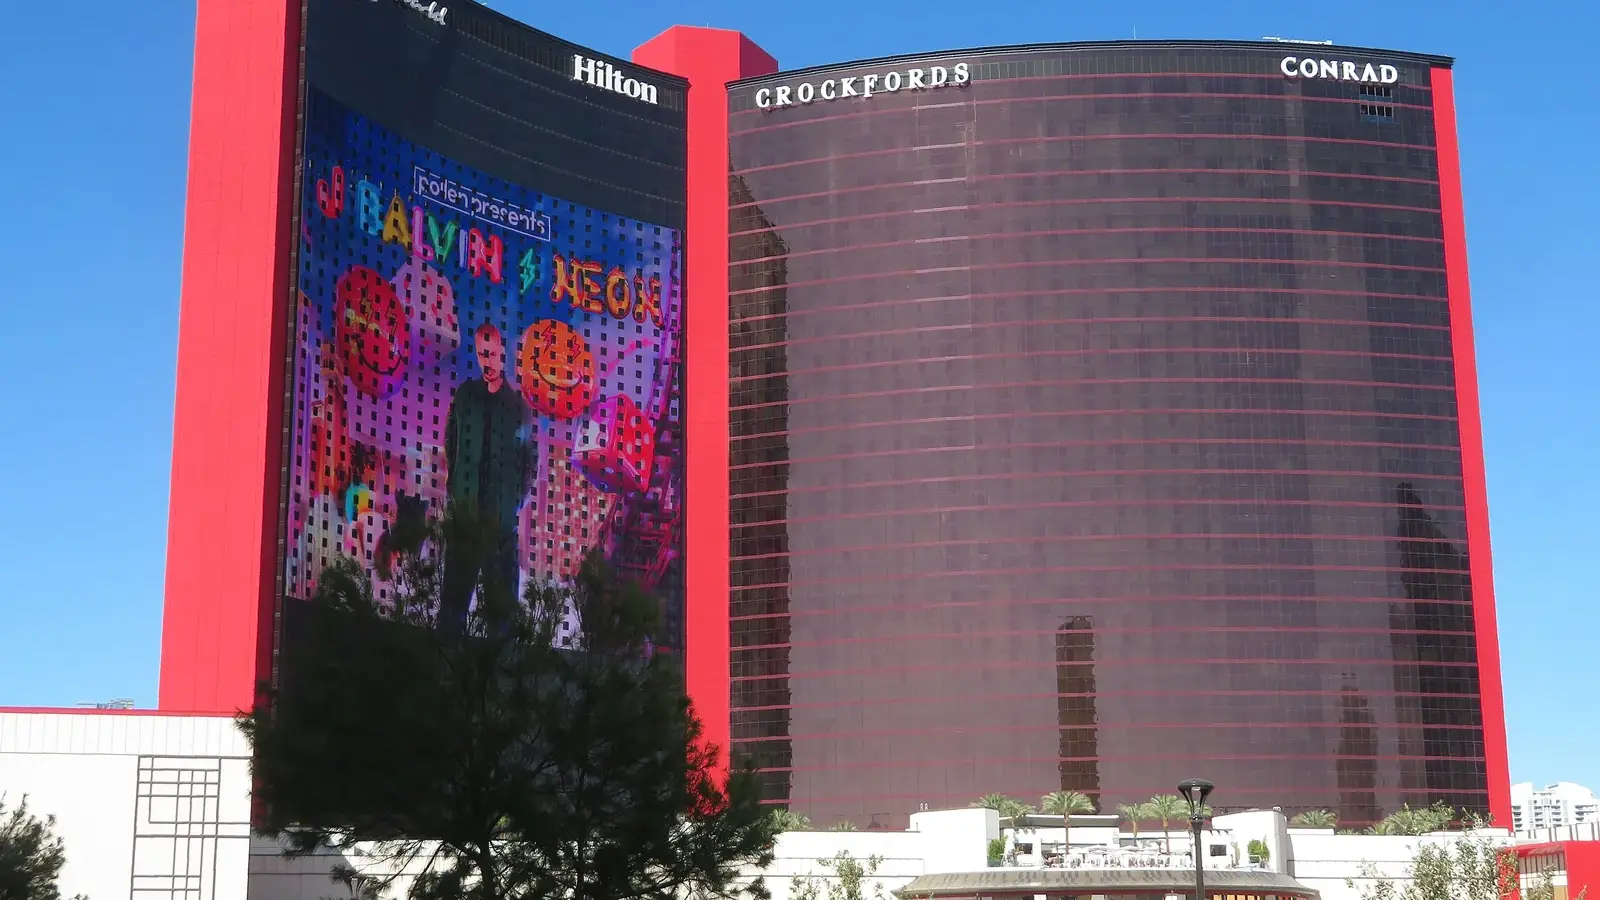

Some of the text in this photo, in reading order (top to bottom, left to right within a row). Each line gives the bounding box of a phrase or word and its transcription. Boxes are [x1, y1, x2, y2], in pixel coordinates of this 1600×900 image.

[397, 0, 448, 25] orld
[573, 54, 658, 104] Hilton
[755, 62, 969, 108] CROCKFORDS
[1280, 57, 1398, 84] CONRAD
[471, 196, 545, 235] presents
[317, 166, 665, 328] J BALVIN NEON
